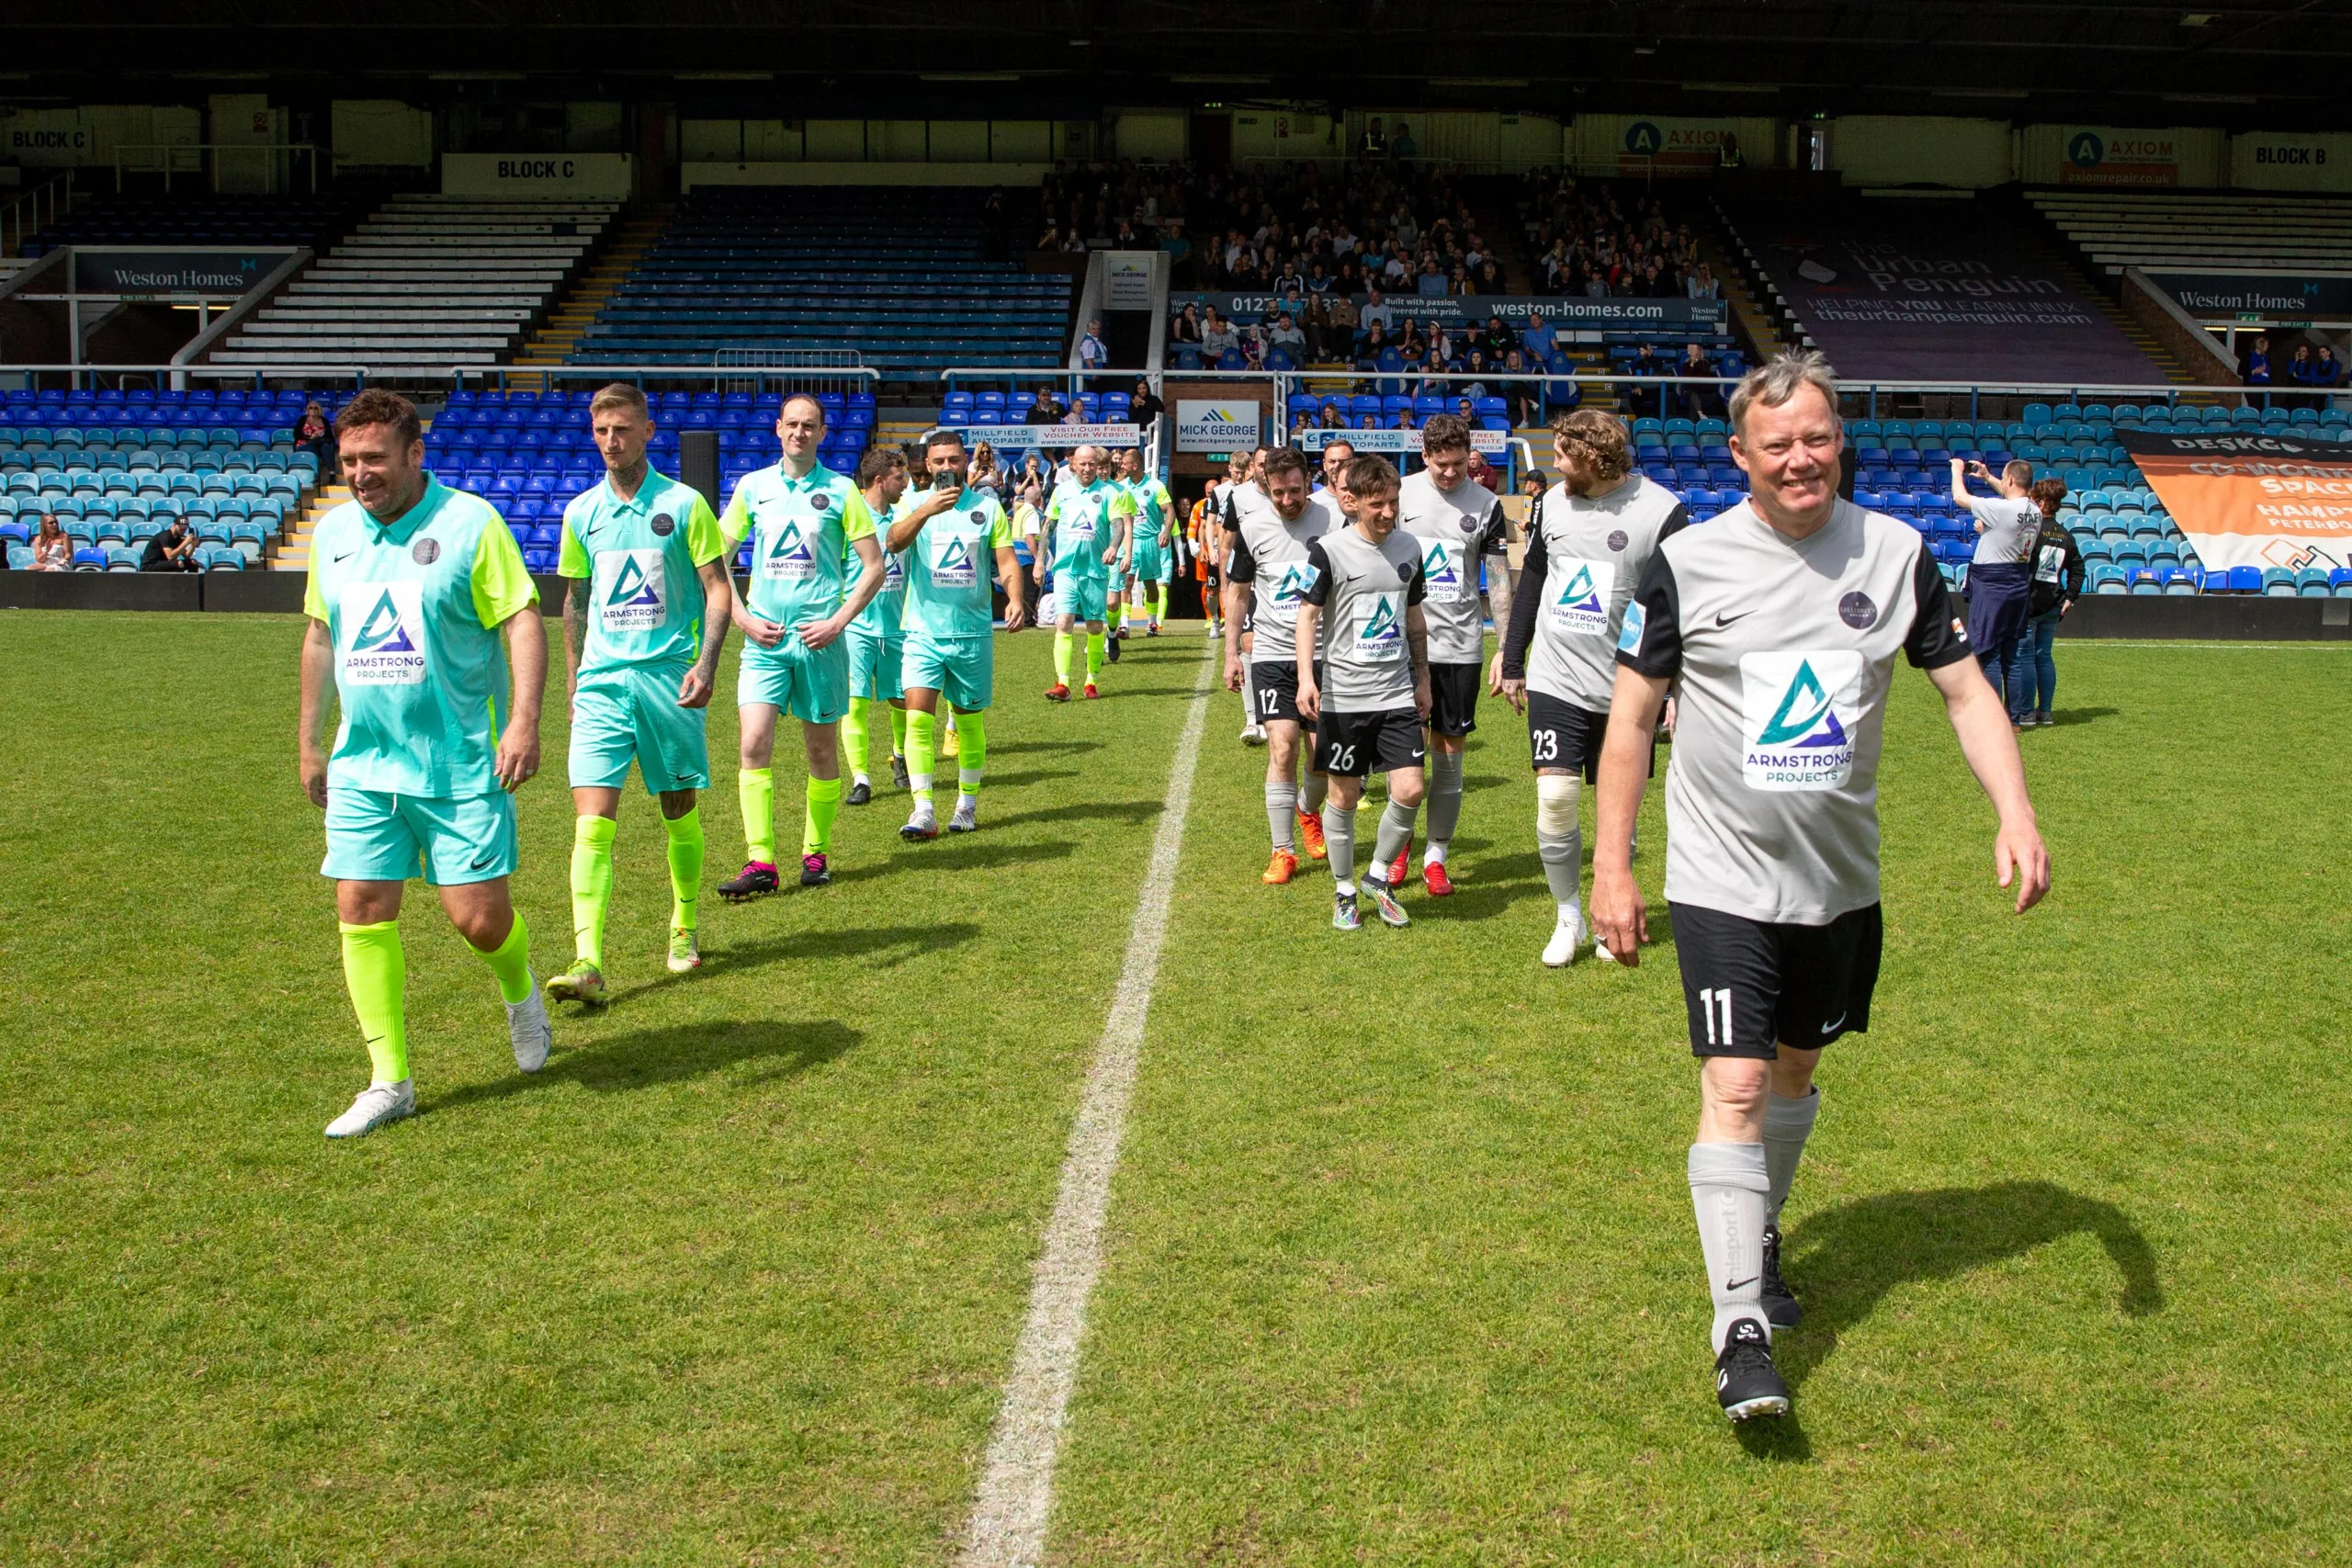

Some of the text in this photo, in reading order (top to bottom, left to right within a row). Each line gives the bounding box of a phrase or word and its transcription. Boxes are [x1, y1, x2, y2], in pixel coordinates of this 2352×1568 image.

[13, 130, 85, 149] BLOCK C
[2110, 141, 2173, 155] AXIOM
[2256, 146, 2326, 164] BLOCK B
[498, 160, 574, 178] BLOCK C
[2068, 171, 2169, 185] axiomrepair.co.uk
[1852, 253, 1993, 275] Urban
[114, 269, 243, 287] Weston Homes
[1869, 273, 2063, 297] Penguin
[1406, 298, 1424, 306] with
[1426, 299, 1459, 308] passion,
[1807, 298, 2083, 314] HELPING YOU LEARN LINUX
[2179, 291, 2306, 310] Weston Homes
[1390, 307, 1419, 315] livered
[1440, 308, 1464, 317] pride.
[1491, 301, 1664, 319] weston-homes.com
[1690, 306, 1719, 314] Weston
[1815, 309, 2094, 325] theurbanpenguin.com
[1180, 424, 1257, 435] MICK GEORGE
[765, 561, 816, 570] ARMSTRONG
[1427, 584, 1461, 592] STRONG
[604, 605, 665, 618] ARMSTRONG
[1552, 608, 1607, 624] ARMSTRONG
[615, 618, 656, 626] PROJECTS
[1558, 619, 1596, 631] PROJECTS
[1355, 639, 1405, 650] ARMSTRONG
[1364, 649, 1397, 658] PROJECTS
[346, 656, 424, 668] ARMSTRONG
[356, 670, 410, 679] PROJECTS
[1259, 688, 1280, 715] 12
[1532, 728, 1558, 761] 23
[1329, 742, 1356, 772] 26
[1747, 750, 1853, 768] ARMSTRONG
[1766, 769, 1838, 783] PROJECTS
[1700, 987, 1733, 1045] 11
